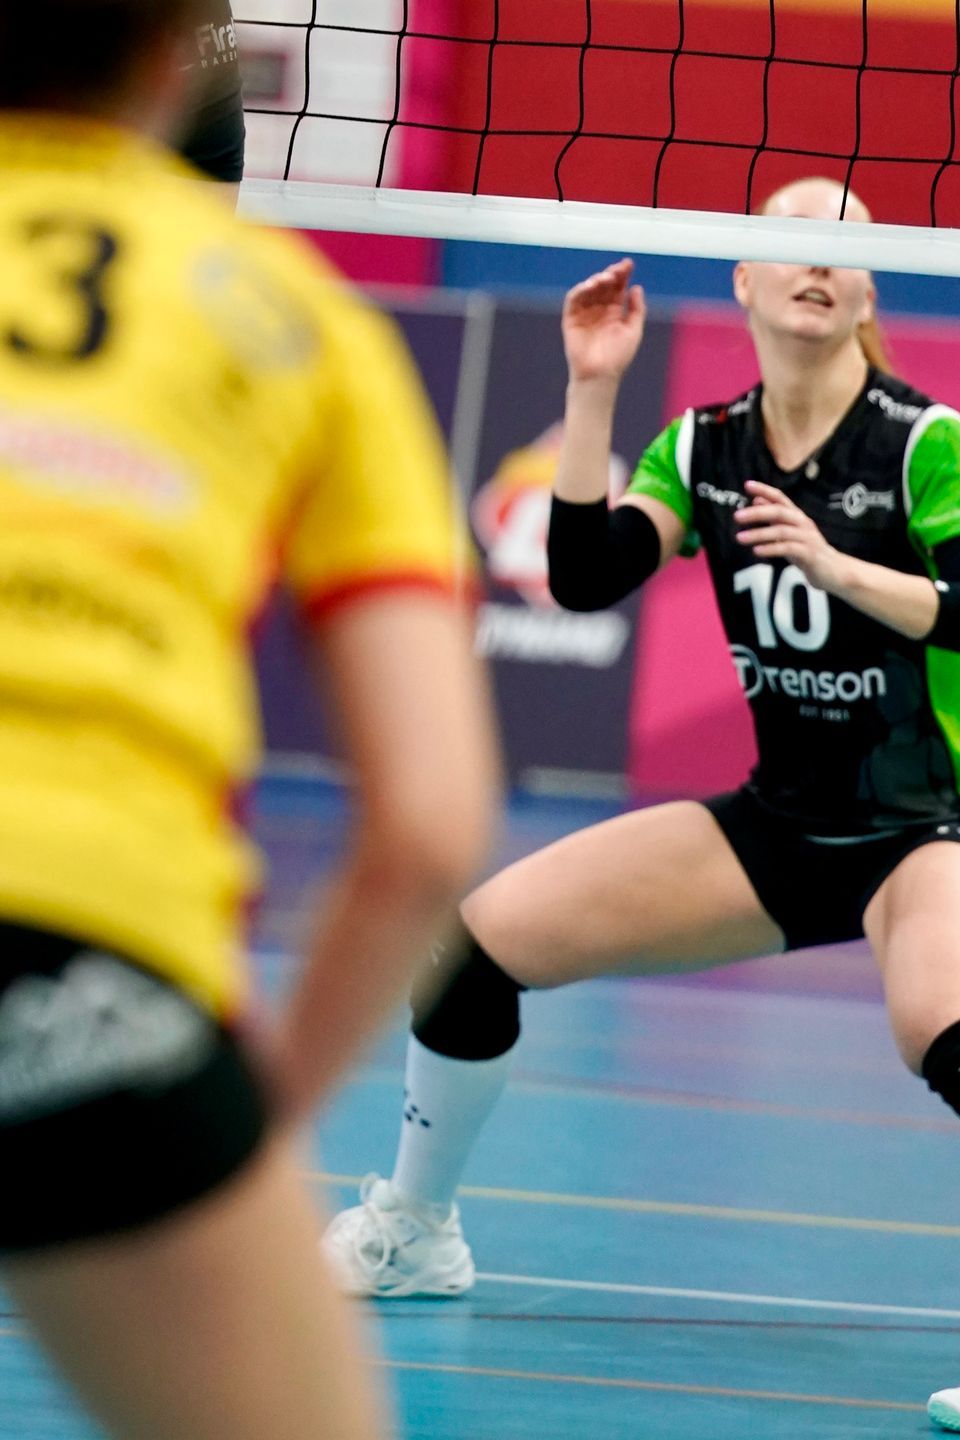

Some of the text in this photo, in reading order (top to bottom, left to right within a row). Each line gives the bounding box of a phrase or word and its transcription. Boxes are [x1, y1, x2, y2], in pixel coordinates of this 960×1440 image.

[195, 16, 237, 58] Fira
[732, 561, 831, 652] 10
[763, 665, 887, 703] renson
